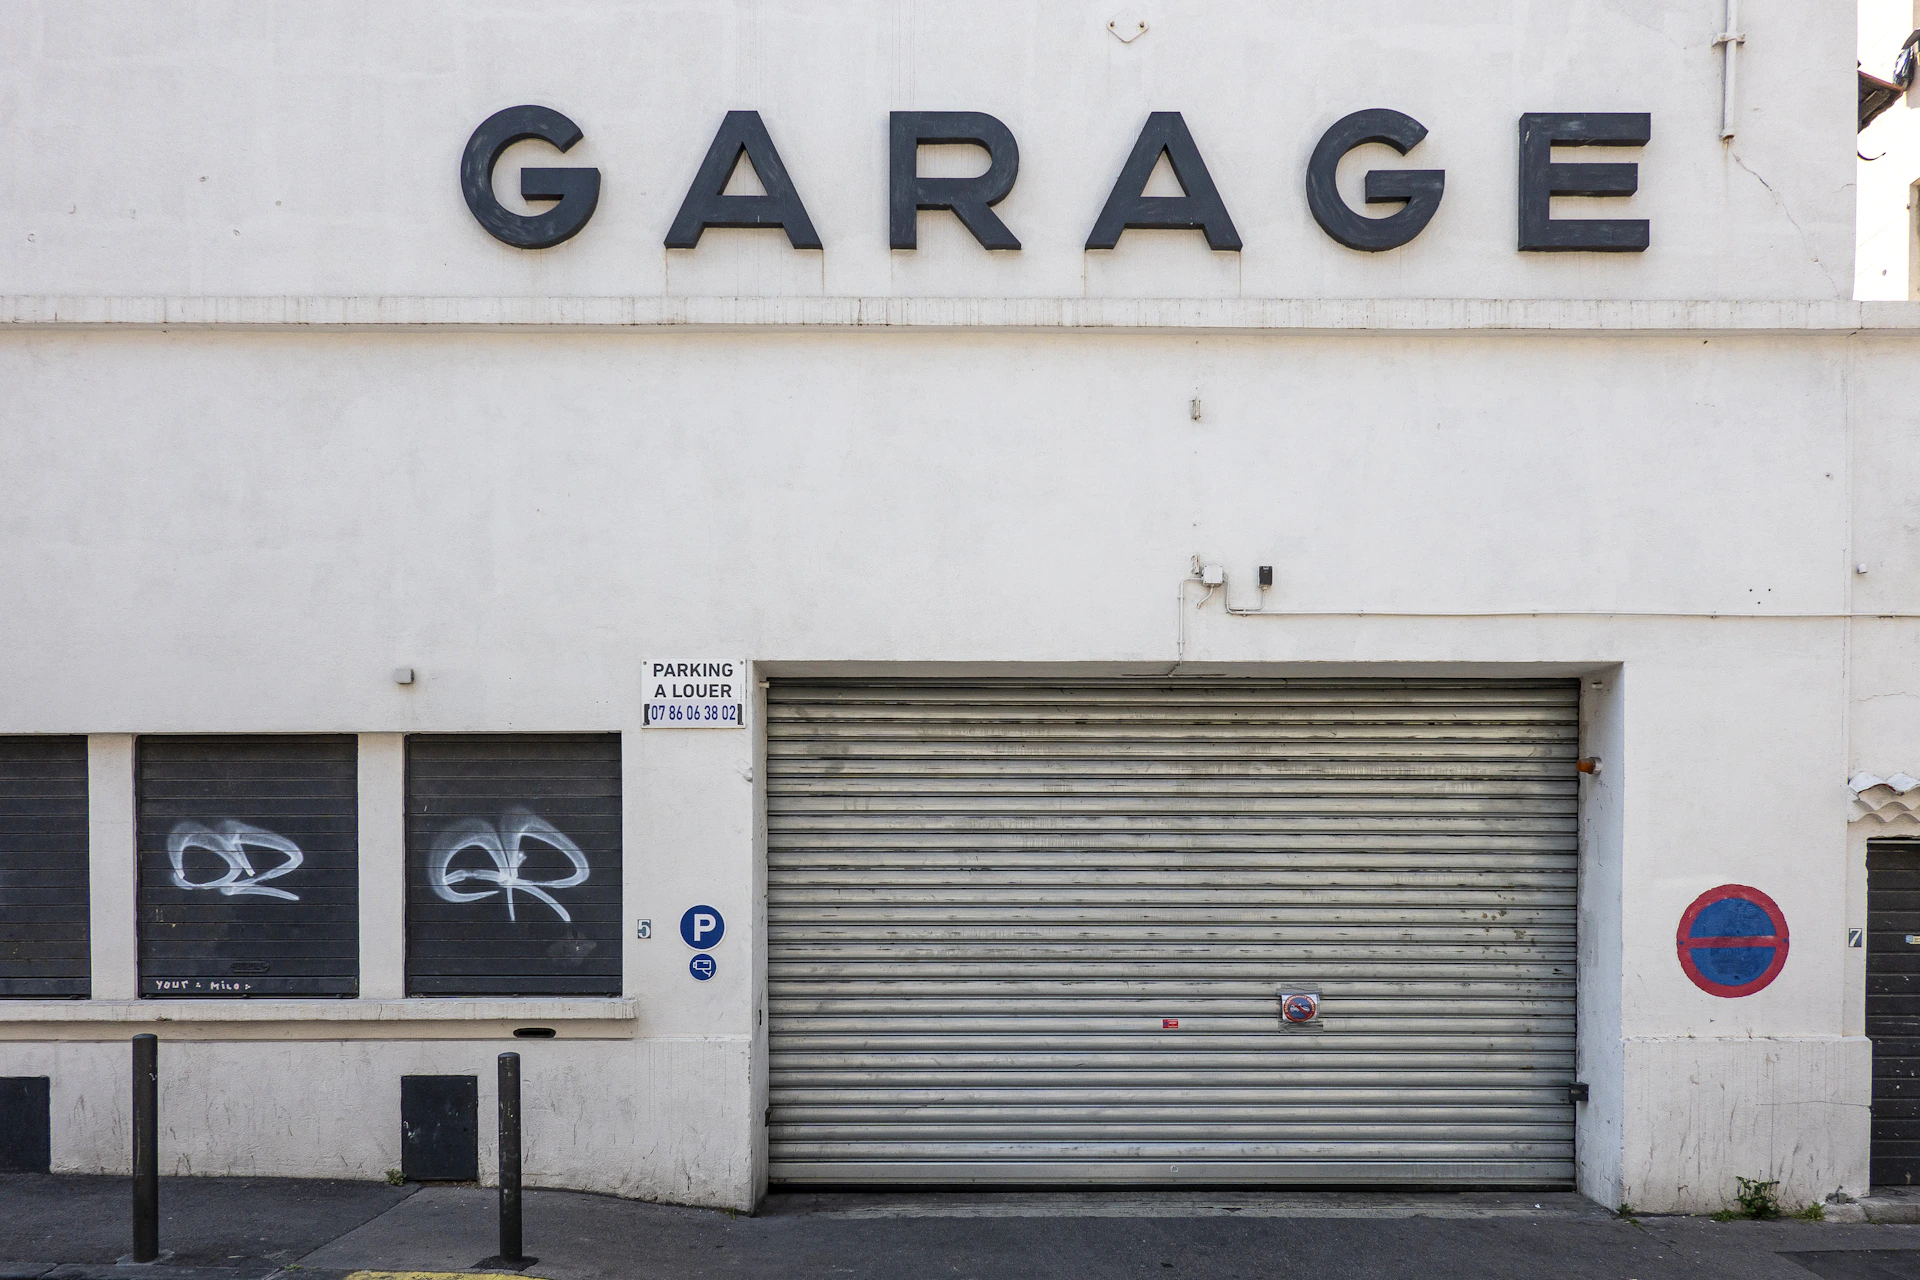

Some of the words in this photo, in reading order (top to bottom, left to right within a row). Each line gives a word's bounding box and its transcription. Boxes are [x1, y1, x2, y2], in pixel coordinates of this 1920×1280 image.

[461, 105, 1652, 253] GARAGE
[653, 663, 734, 678] PARKING
[654, 684, 667, 698] A
[673, 684, 732, 698] LOUER
[651, 705, 666, 721] 07
[669, 705, 683, 721] 86
[686, 705, 701, 721] 06
[704, 705, 718, 721] 38
[722, 705, 736, 721] 02
[638, 919, 651, 938] 5
[694, 914, 717, 942] P
[1849, 928, 1862, 947] 7
